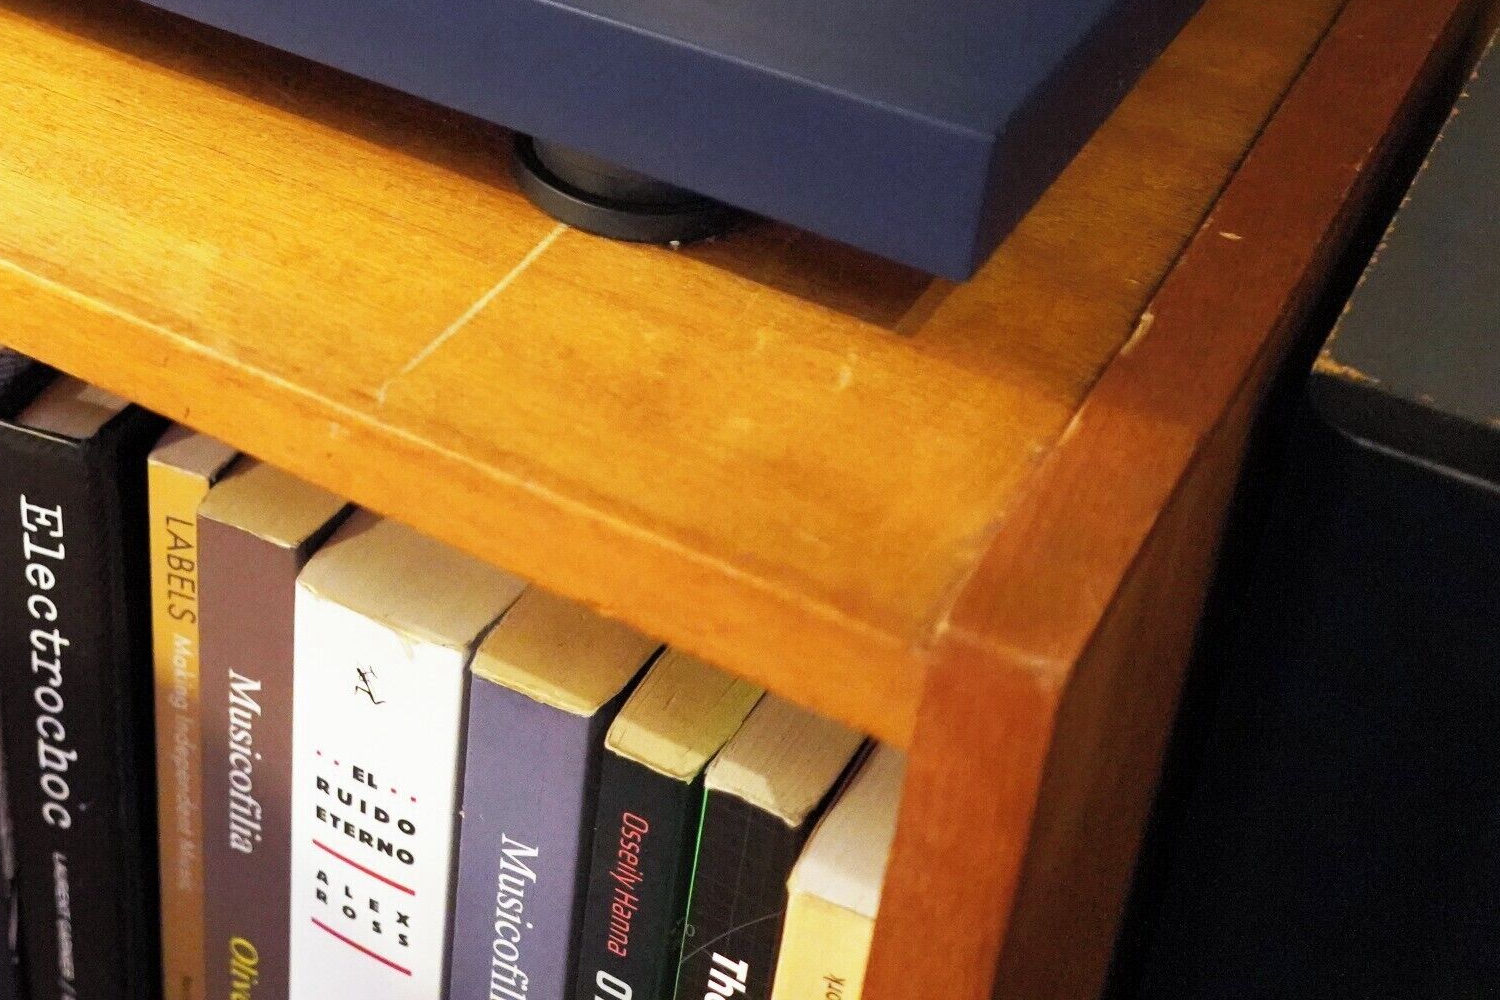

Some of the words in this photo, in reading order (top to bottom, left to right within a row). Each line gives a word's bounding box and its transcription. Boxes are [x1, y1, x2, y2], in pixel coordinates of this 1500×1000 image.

[165, 516, 197, 624] LABELS
[20, 494, 78, 829] Electrochoc
[169, 633, 197, 710] Making
[228, 668, 263, 855] Musicofilia
[352, 765, 378, 790] EL
[316, 776, 416, 836] RUIDO
[316, 805, 414, 865] ETERNO
[609, 812, 649, 890] Osseily
[316, 869, 410, 928] ALEX
[316, 887, 409, 947] ROSS
[489, 832, 539, 1000] Musicofil
[607, 887, 640, 957] Hanna
